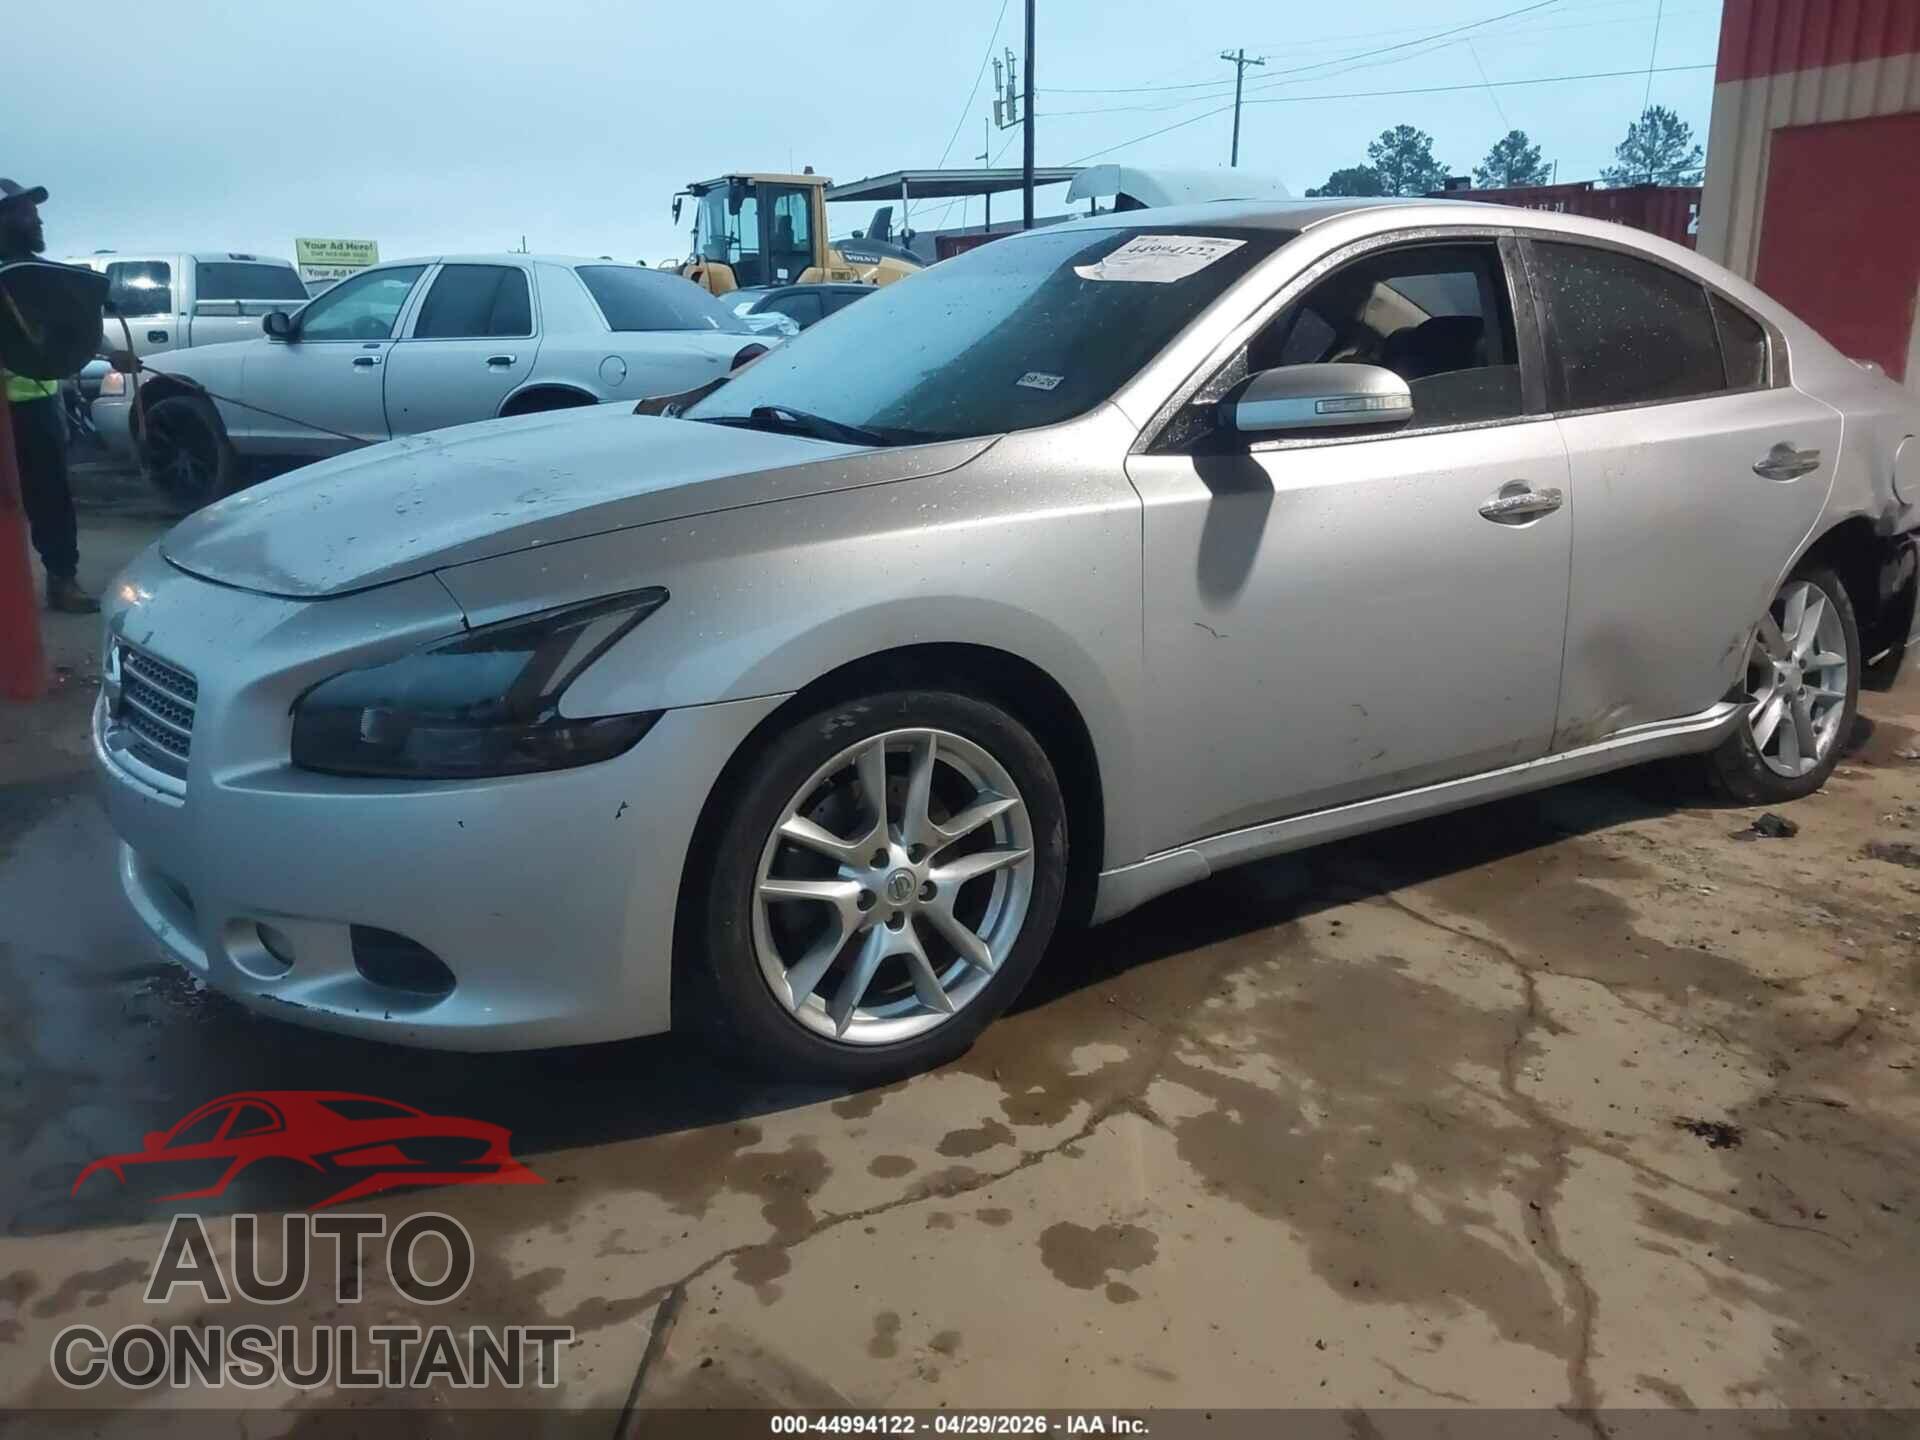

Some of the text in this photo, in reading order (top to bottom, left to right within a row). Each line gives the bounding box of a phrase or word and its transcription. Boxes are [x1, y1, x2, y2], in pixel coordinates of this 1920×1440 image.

[303, 241, 373, 251] Your Ad Here!
[845, 254, 879, 263] VOLVO
[306, 268, 331, 277] Your
[333, 269, 346, 277] Ad
